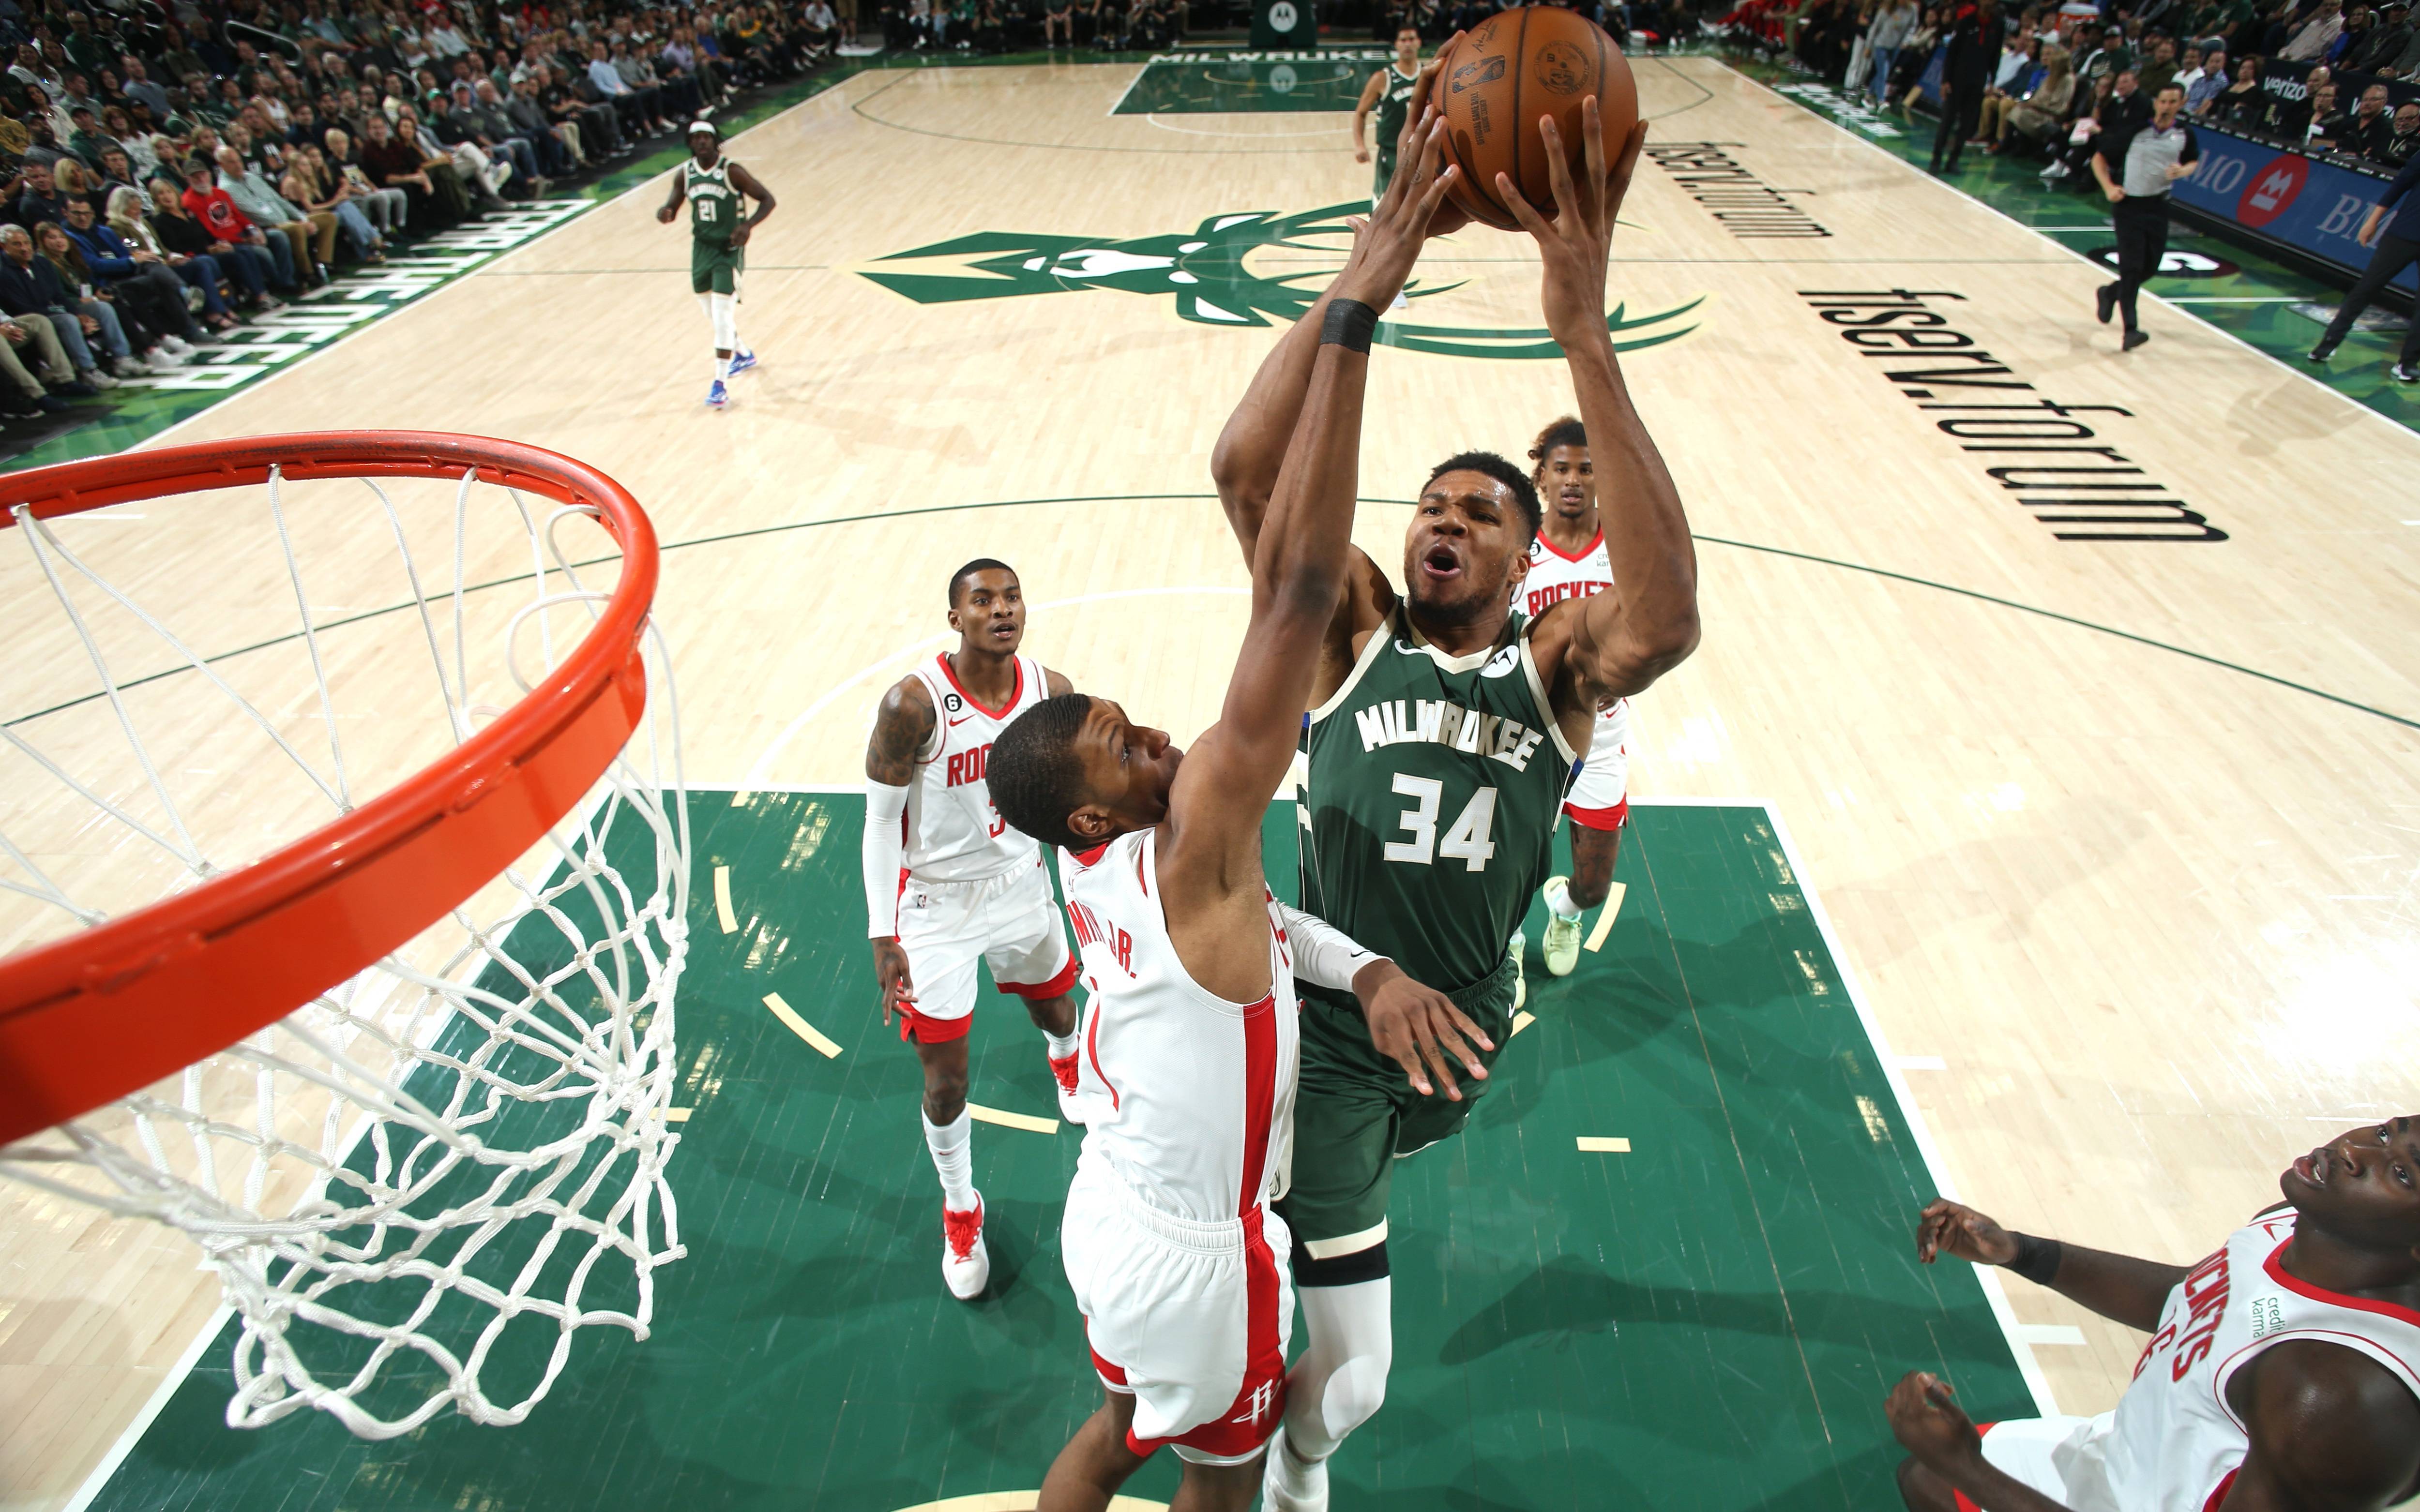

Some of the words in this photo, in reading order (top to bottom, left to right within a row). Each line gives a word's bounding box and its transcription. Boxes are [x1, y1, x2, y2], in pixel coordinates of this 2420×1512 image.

[2263, 76, 2307, 101] verizo
[2182, 149, 2246, 194] MO
[697, 199, 718, 222] 21
[2316, 193, 2398, 249] BM
[1797, 288, 2230, 542] fiserv.forum
[947, 695, 958, 711] 6
[1355, 699, 1544, 773] MILWAUKEE
[1384, 772, 1497, 872] 34
[1107, 919, 1137, 979] JR.
[2252, 1297, 2266, 1339] karma
[2267, 1297, 2286, 1333] credit
